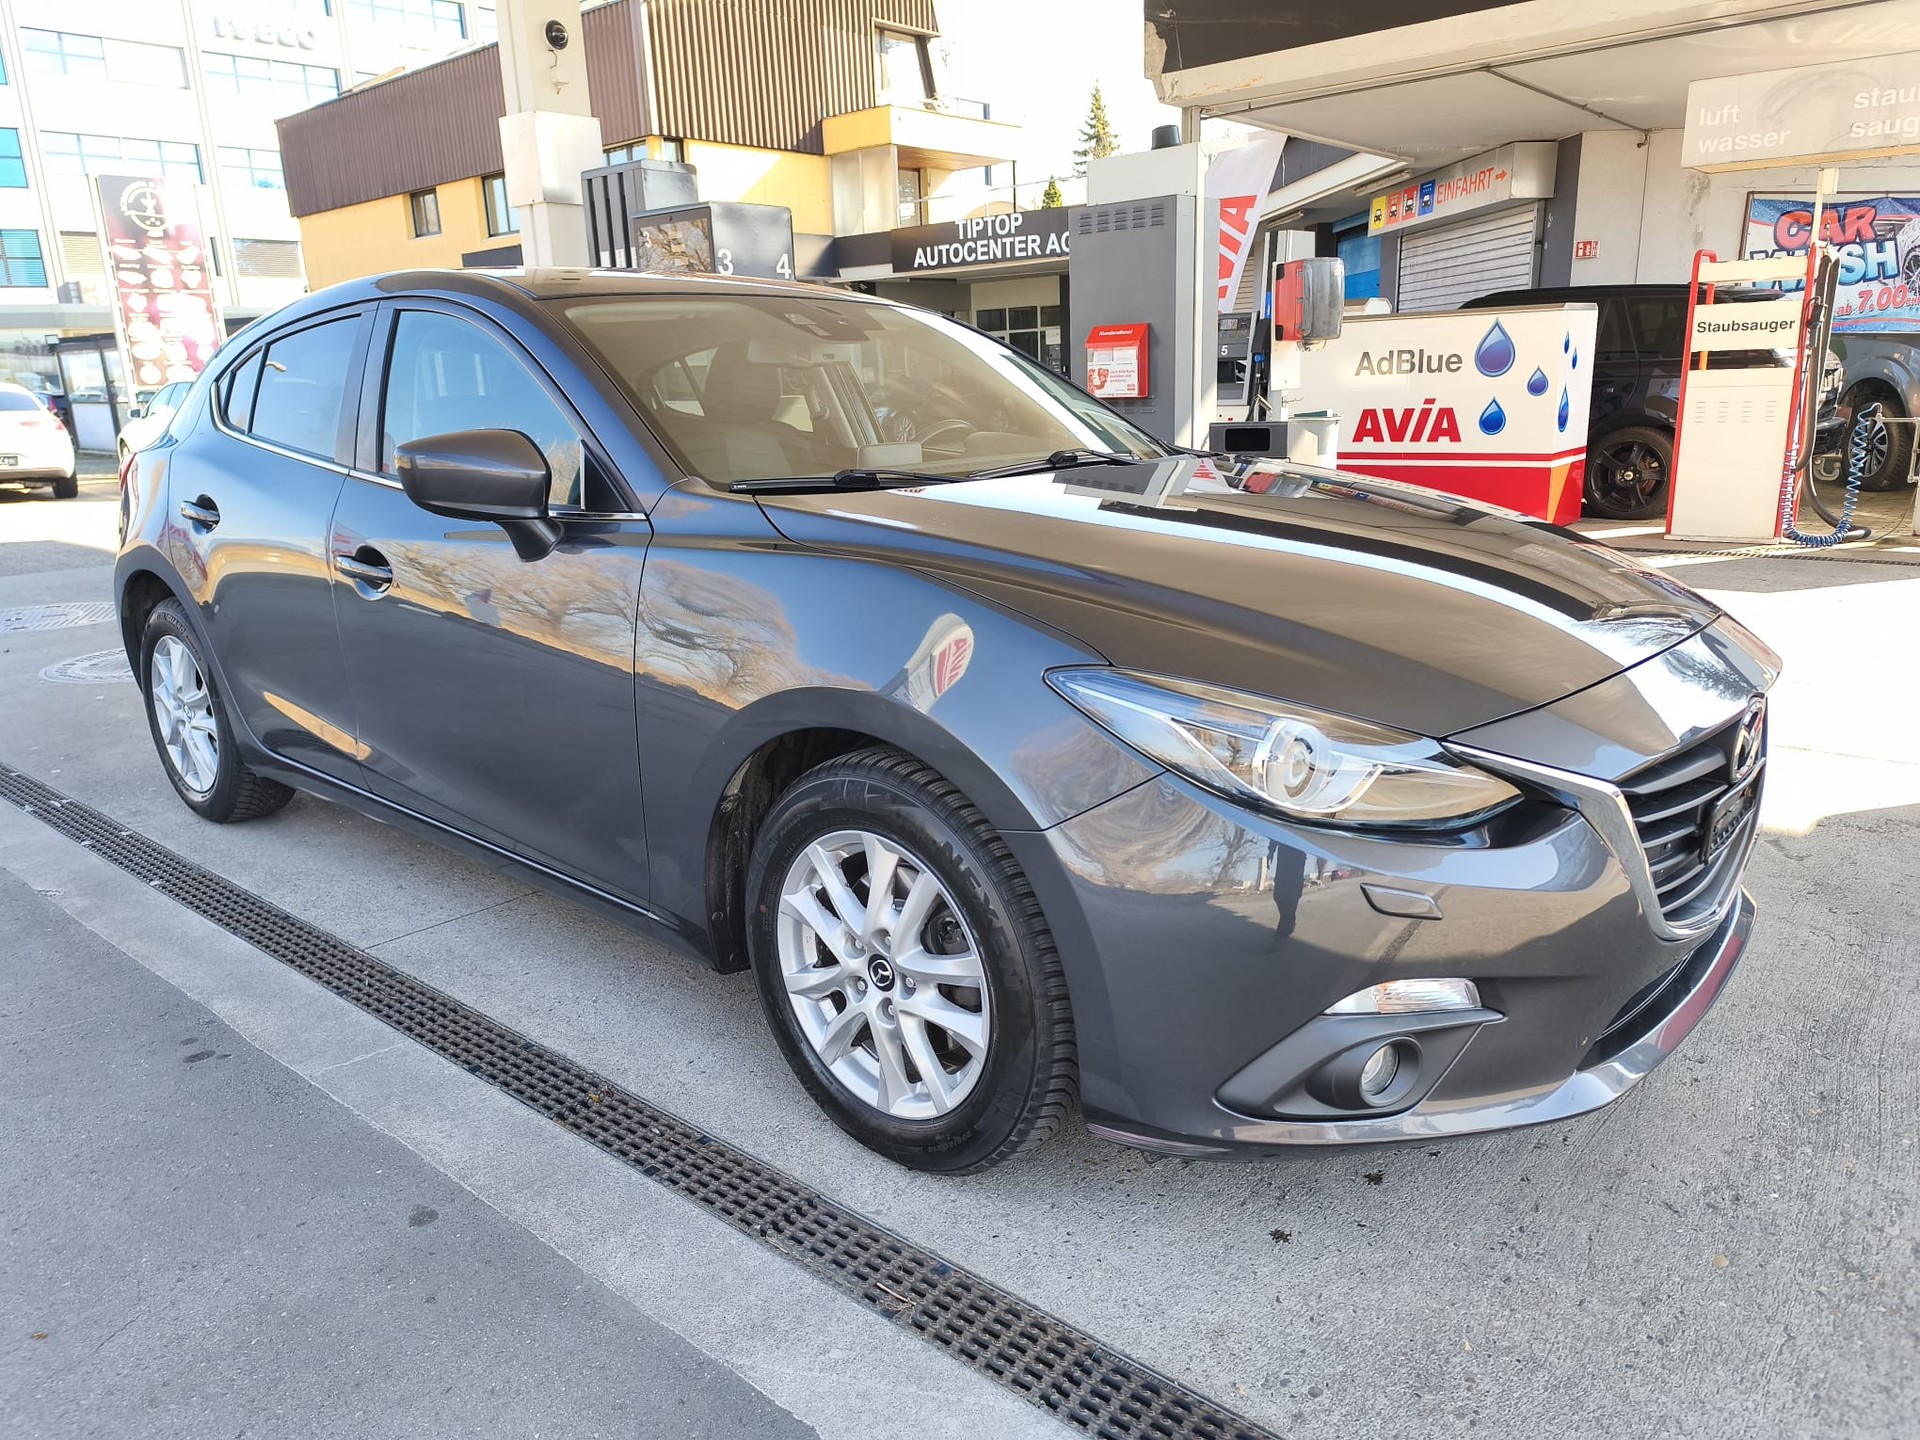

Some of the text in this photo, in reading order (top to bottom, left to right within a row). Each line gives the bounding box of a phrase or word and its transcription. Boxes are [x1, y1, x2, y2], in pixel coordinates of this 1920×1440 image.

[1853, 86, 1920, 109] stau
[1698, 104, 1741, 127] luft
[1697, 129, 1792, 153] wasser
[1436, 167, 1495, 205] EINFAHRT
[954, 212, 1023, 240] TIPTOP
[1774, 205, 1878, 249] CAR
[717, 249, 734, 276] 3
[913, 234, 1042, 268] AUTOCENTER
[775, 253, 792, 279] 4
[1836, 303, 1853, 317] ab
[1858, 284, 1909, 314] 7.00
[1696, 320, 1796, 333] Staubsauger
[1220, 345, 1228, 356] 5
[1354, 348, 1463, 376] AdBlue
[1351, 398, 1462, 443] AVIA
